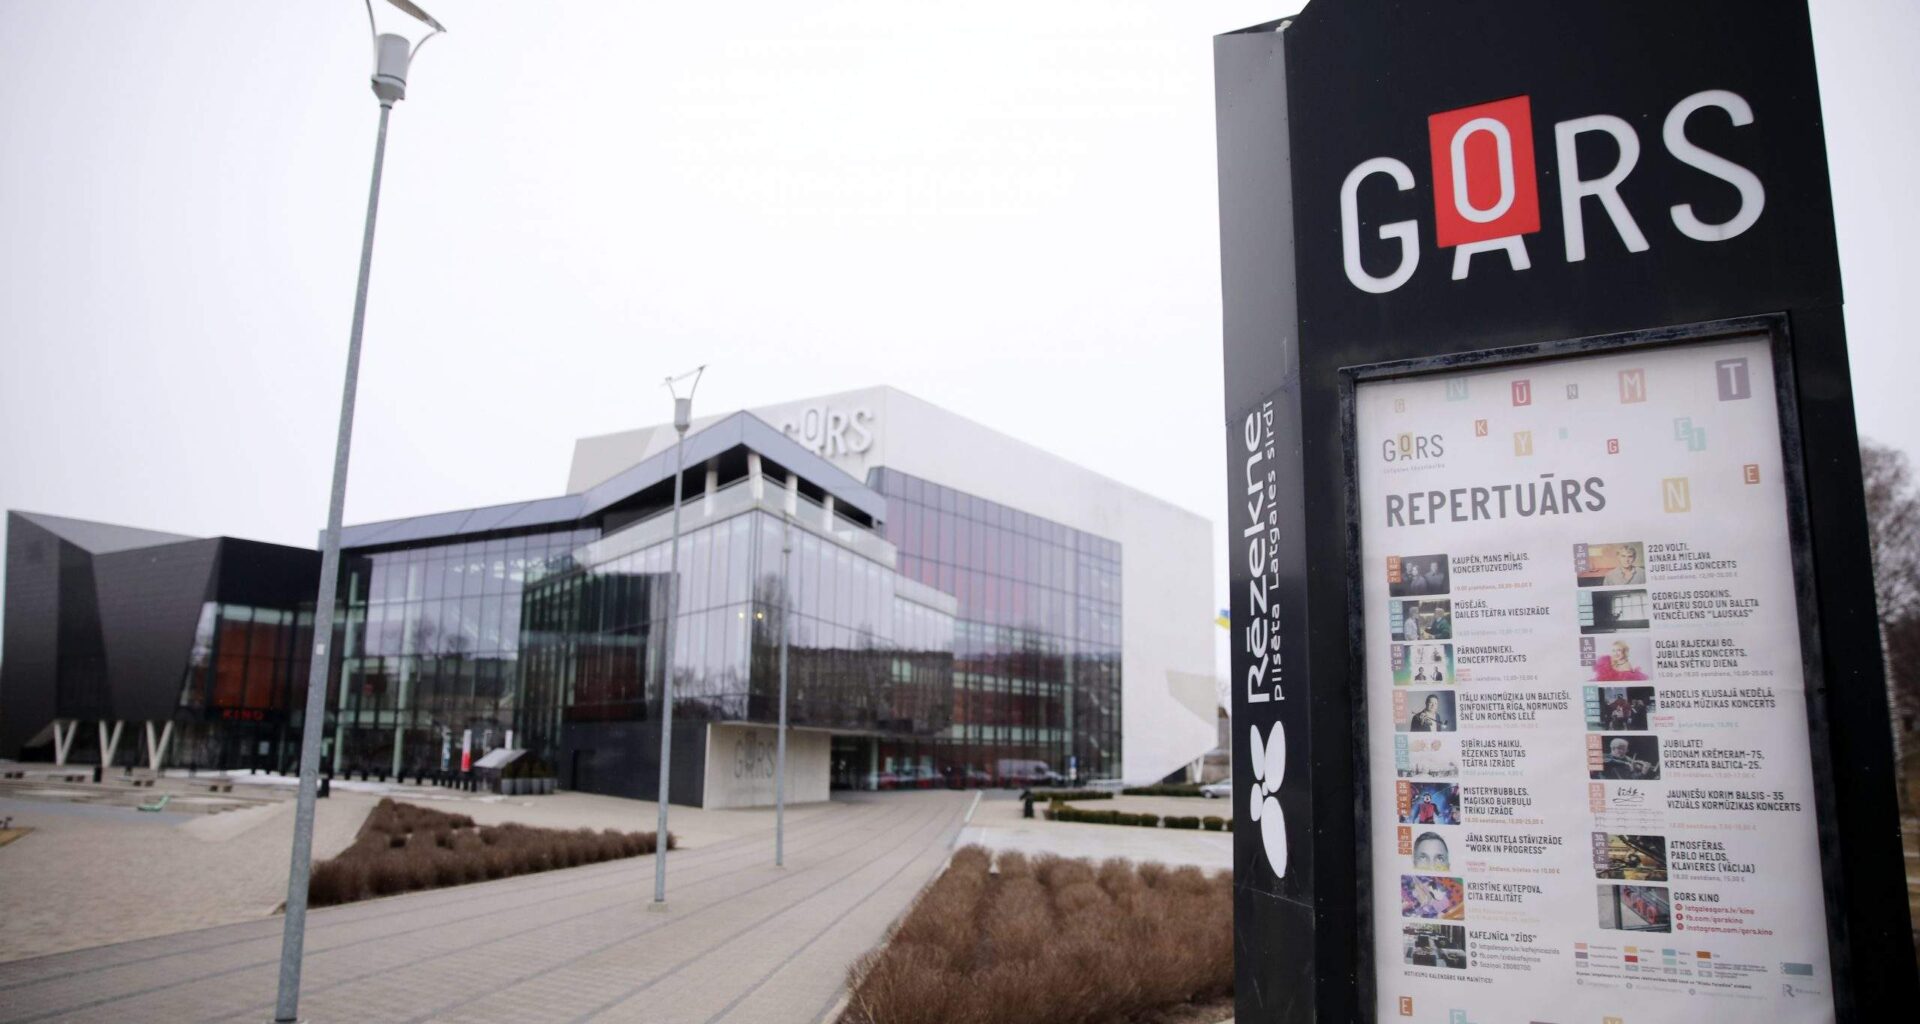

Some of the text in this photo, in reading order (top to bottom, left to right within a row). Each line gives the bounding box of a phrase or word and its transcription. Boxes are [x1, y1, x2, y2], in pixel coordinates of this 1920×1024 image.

[1340, 88, 1766, 294] GORS
[1622, 371, 1643, 401] M
[1720, 361, 1743, 396] T
[1665, 479, 1687, 511] N
[1385, 473, 1606, 528] REPERTUĀRS
[1267, 470, 1280, 590] Latgales
[1648, 544, 1664, 553] 220
[1244, 411, 1270, 703] Rēzekne
[1483, 554, 1502, 563] MANS
[1649, 552, 1712, 562] AINARA MIELAVA
[1453, 563, 1523, 574] KONCERTUZVEDUMS
[1650, 560, 1737, 573] JUBILEJAS KONCERTS
[1652, 591, 1692, 601] GEORGIJS
[1652, 598, 1760, 610] KLAVIERU SOLO UN BALETA
[1455, 610, 1480, 619] DAILES
[1508, 606, 1550, 616] VIESIZRĀDE
[1655, 640, 1679, 649] OLGAI
[1680, 639, 1719, 649] RAJECKAI
[1457, 655, 1527, 664] KONCERTPROJEKTS
[1656, 650, 1700, 659] JUBILEJAS
[1657, 660, 1679, 669] MANA
[1713, 659, 1738, 668] DIENA
[1526, 692, 1536, 700] UN
[1659, 689, 1700, 699] HENDELIS
[1460, 703, 1505, 712] SINFONIETTA
[1526, 702, 1568, 711] NORMUNDS
[1660, 698, 1776, 709] BAROKA MŪZIKAS KONCERTS
[1663, 739, 1703, 748] JUBILATE!
[1500, 750, 1526, 758] TAUTAS
[1663, 750, 1700, 759] GIDONAM
[1664, 760, 1710, 769] KREMERATA
[1666, 788, 1706, 799] JAUNIEŠU
[1708, 790, 1734, 800] KORIM
[1735, 791, 1765, 800] BALSIS
[1772, 791, 1785, 801] 35
[1464, 806, 1486, 815] TRIKU
[1701, 800, 1755, 811] KORMŪZIKAS
[1756, 802, 1802, 812] KONCERTS
[1493, 845, 1501, 853] IN
[1671, 851, 1697, 861] PABLO
[1671, 862, 1716, 872] KLAVIERES
[1467, 892, 1484, 901] CITA
[1673, 892, 1720, 903] GORS KINO
